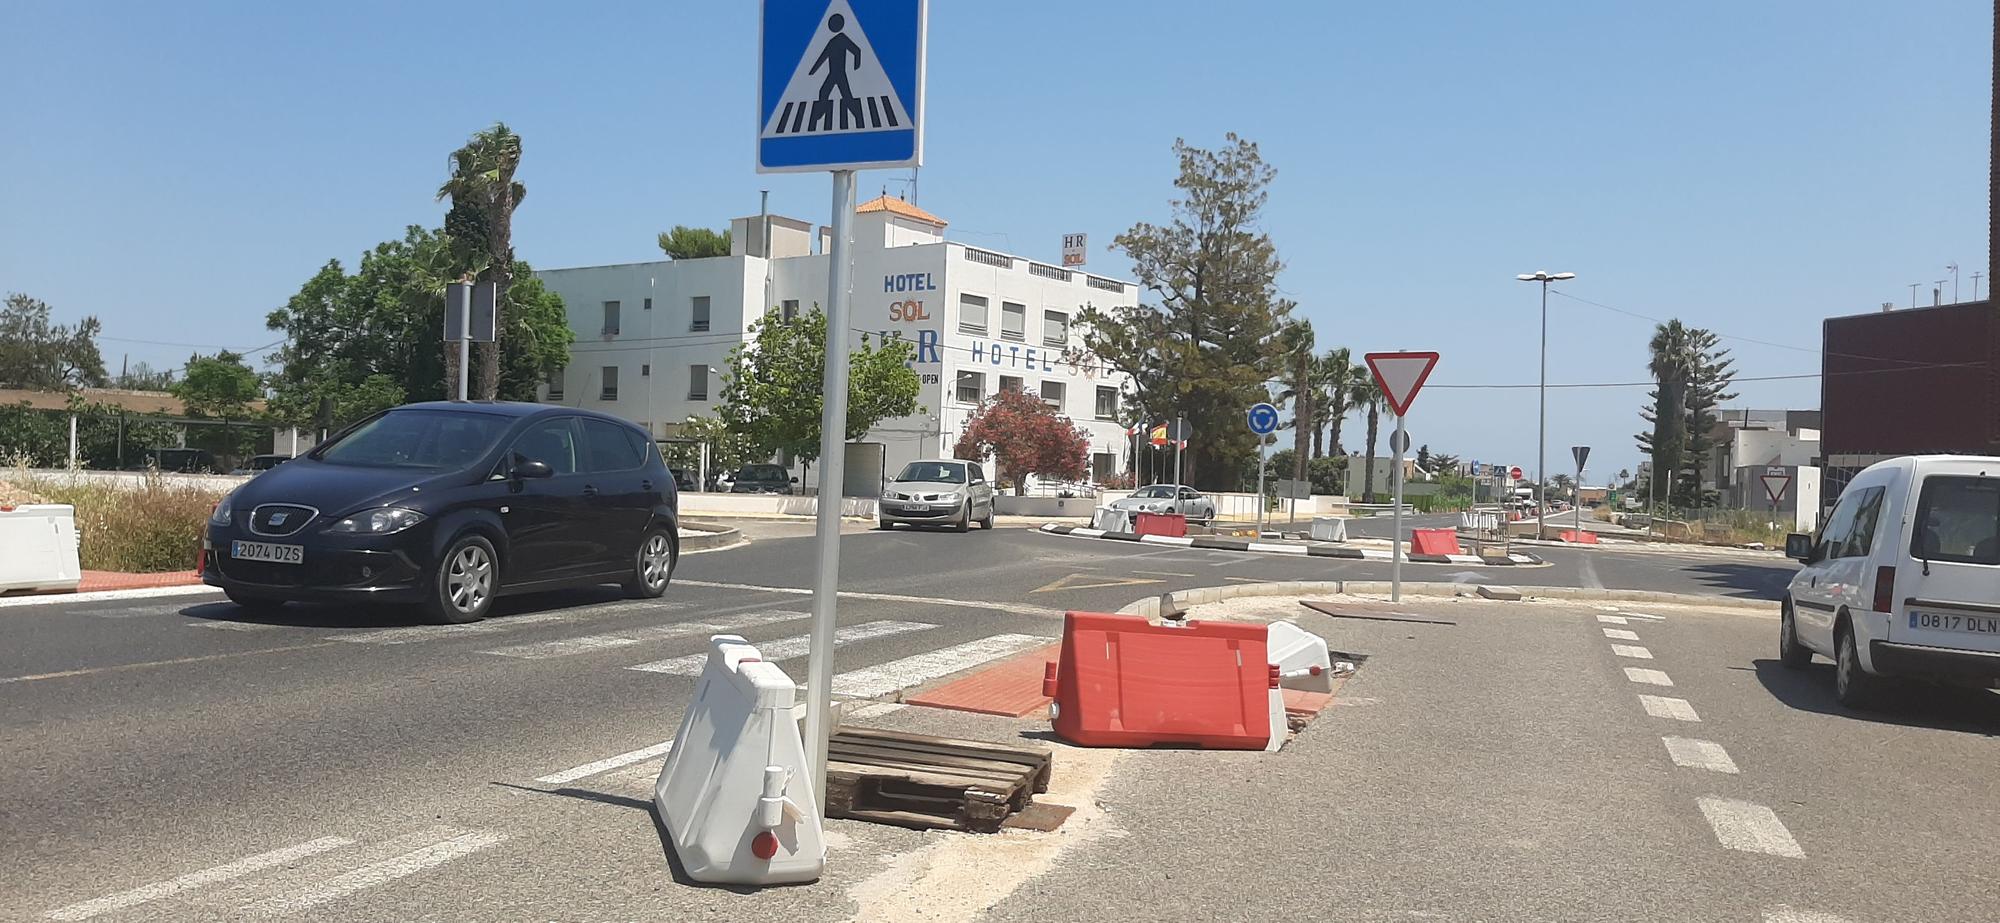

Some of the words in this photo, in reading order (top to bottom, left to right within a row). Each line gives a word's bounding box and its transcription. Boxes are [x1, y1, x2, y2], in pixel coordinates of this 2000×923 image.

[884, 272, 936, 293] HOTEL
[889, 300, 931, 323] SOL
[971, 340, 1052, 372] HOTEL
[922, 374, 938, 384] OPEN
[240, 543, 270, 559] 2074
[275, 546, 300, 561] DZS
[1921, 614, 1961, 629] 0817
[1967, 618, 1997, 633] DLN
